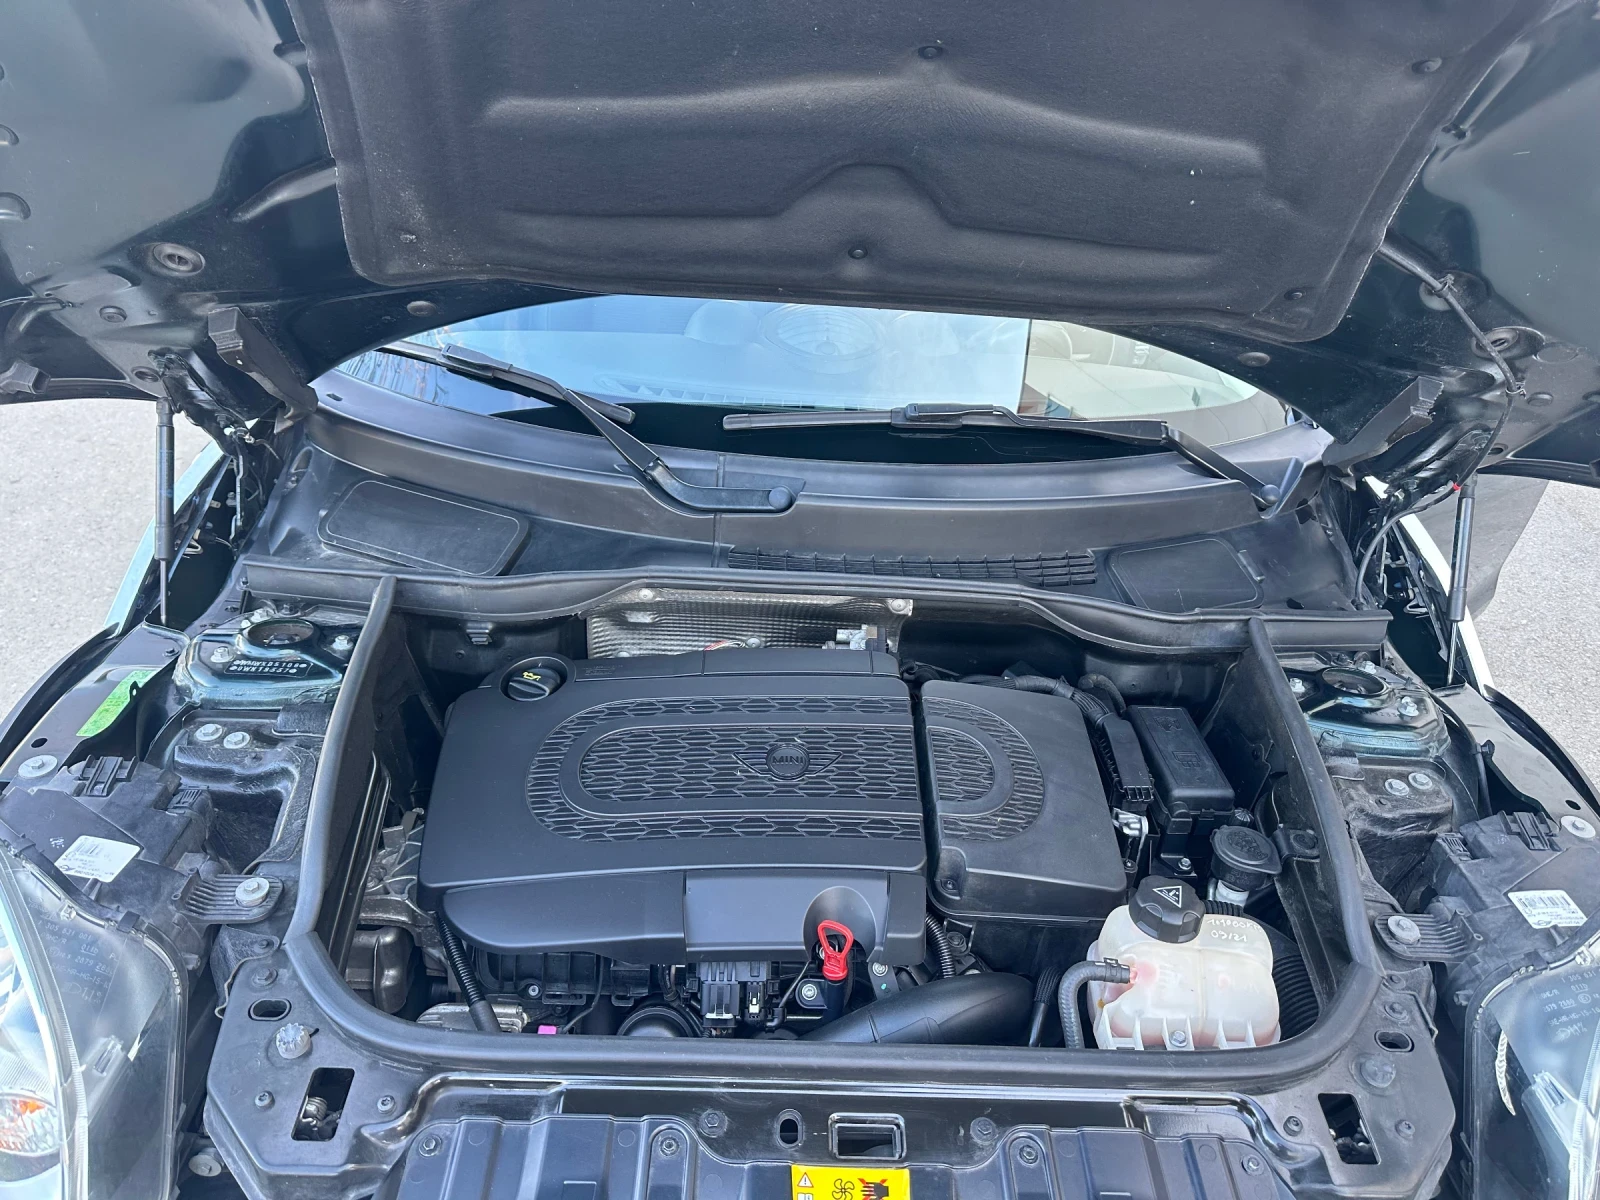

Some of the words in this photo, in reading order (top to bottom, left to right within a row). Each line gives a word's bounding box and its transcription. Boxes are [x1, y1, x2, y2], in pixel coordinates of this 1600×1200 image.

[772, 755, 804, 764] MINI
[45, 922, 60, 931] 305
[1567, 973, 1582, 982] 305
